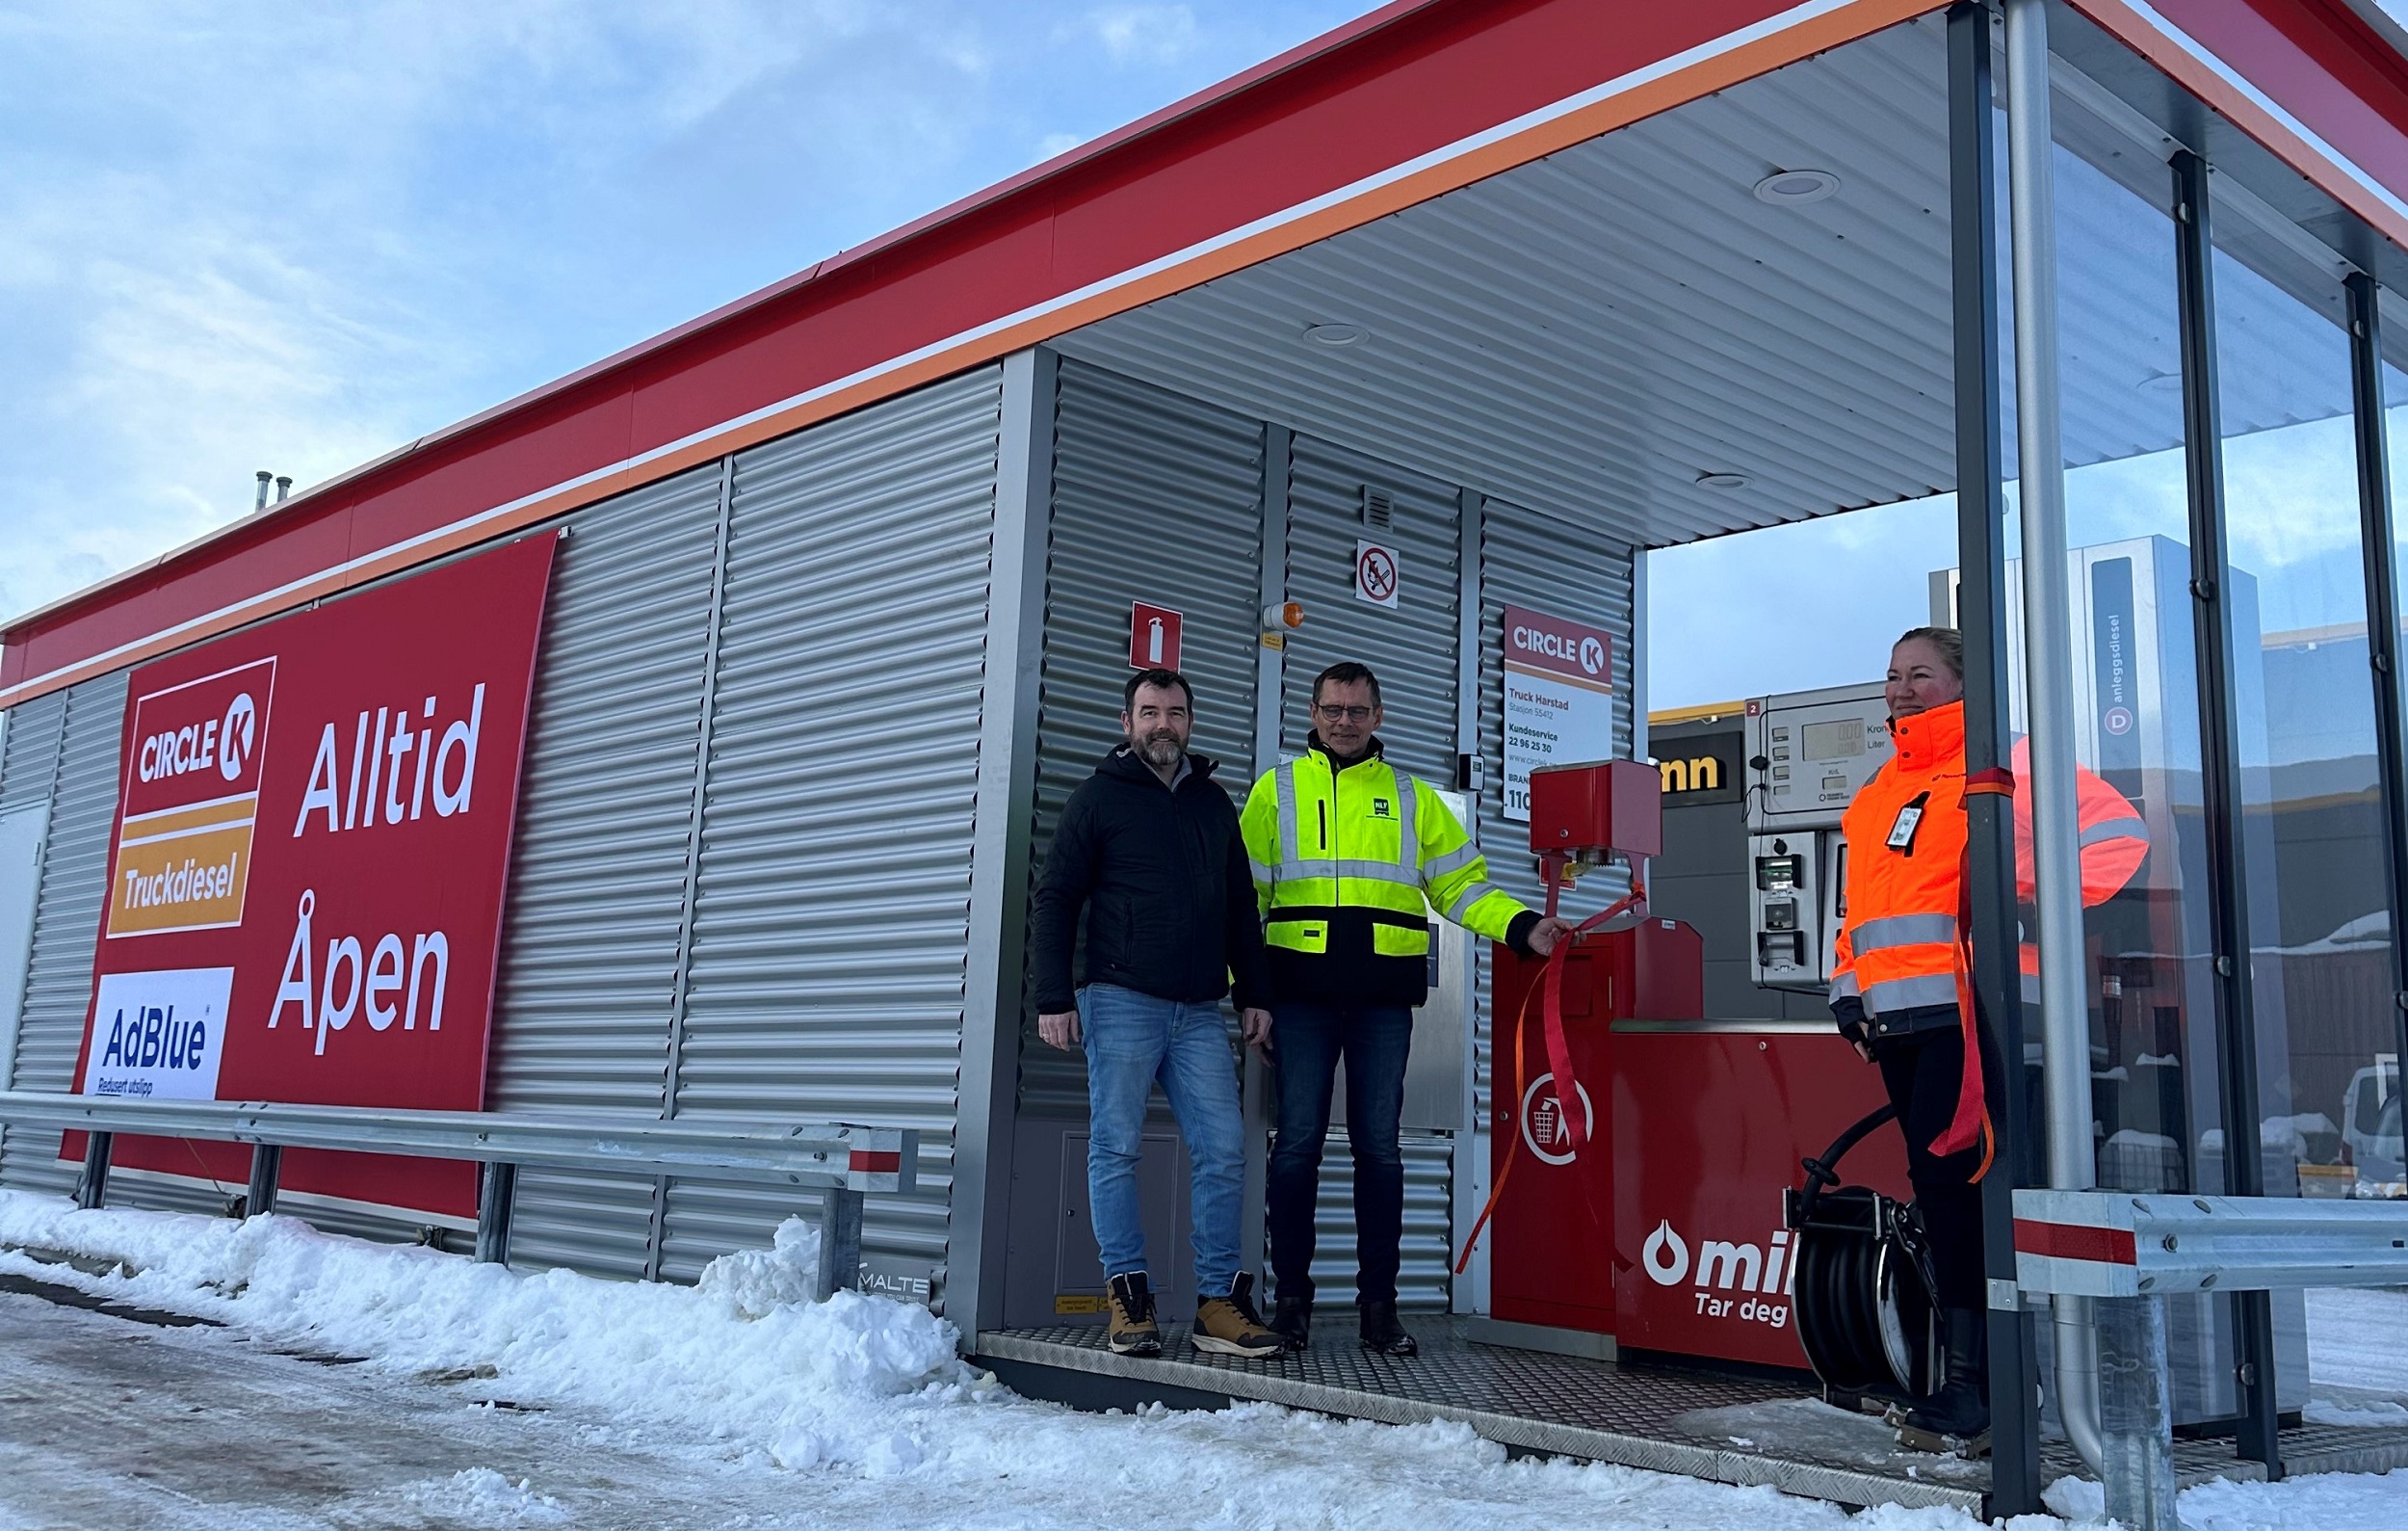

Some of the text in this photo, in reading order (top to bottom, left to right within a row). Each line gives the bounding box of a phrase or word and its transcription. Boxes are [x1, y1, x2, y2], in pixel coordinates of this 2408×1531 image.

[1513, 625, 1604, 673] CIRCLE K
[2107, 614, 2124, 703] anleggsdiesel
[1508, 687, 1569, 711] Truck Harstad
[1508, 701, 1533, 716] Stasjon
[1750, 704, 1757, 714] 2
[139, 701, 253, 783] CIRCLE K
[1508, 723, 1558, 742] Kundeservice
[1508, 736, 1552, 753] 22 96 25 30
[1867, 740, 1885, 749] Liter
[292, 682, 485, 838] Alltid
[123, 852, 238, 911] Truckdiesel
[267, 888, 449, 1056] Åpen
[102, 1004, 206, 1070] AdBlue
[97, 1076, 153, 1098] Redusert utslipp
[1694, 1292, 1788, 1328] Tar deg
